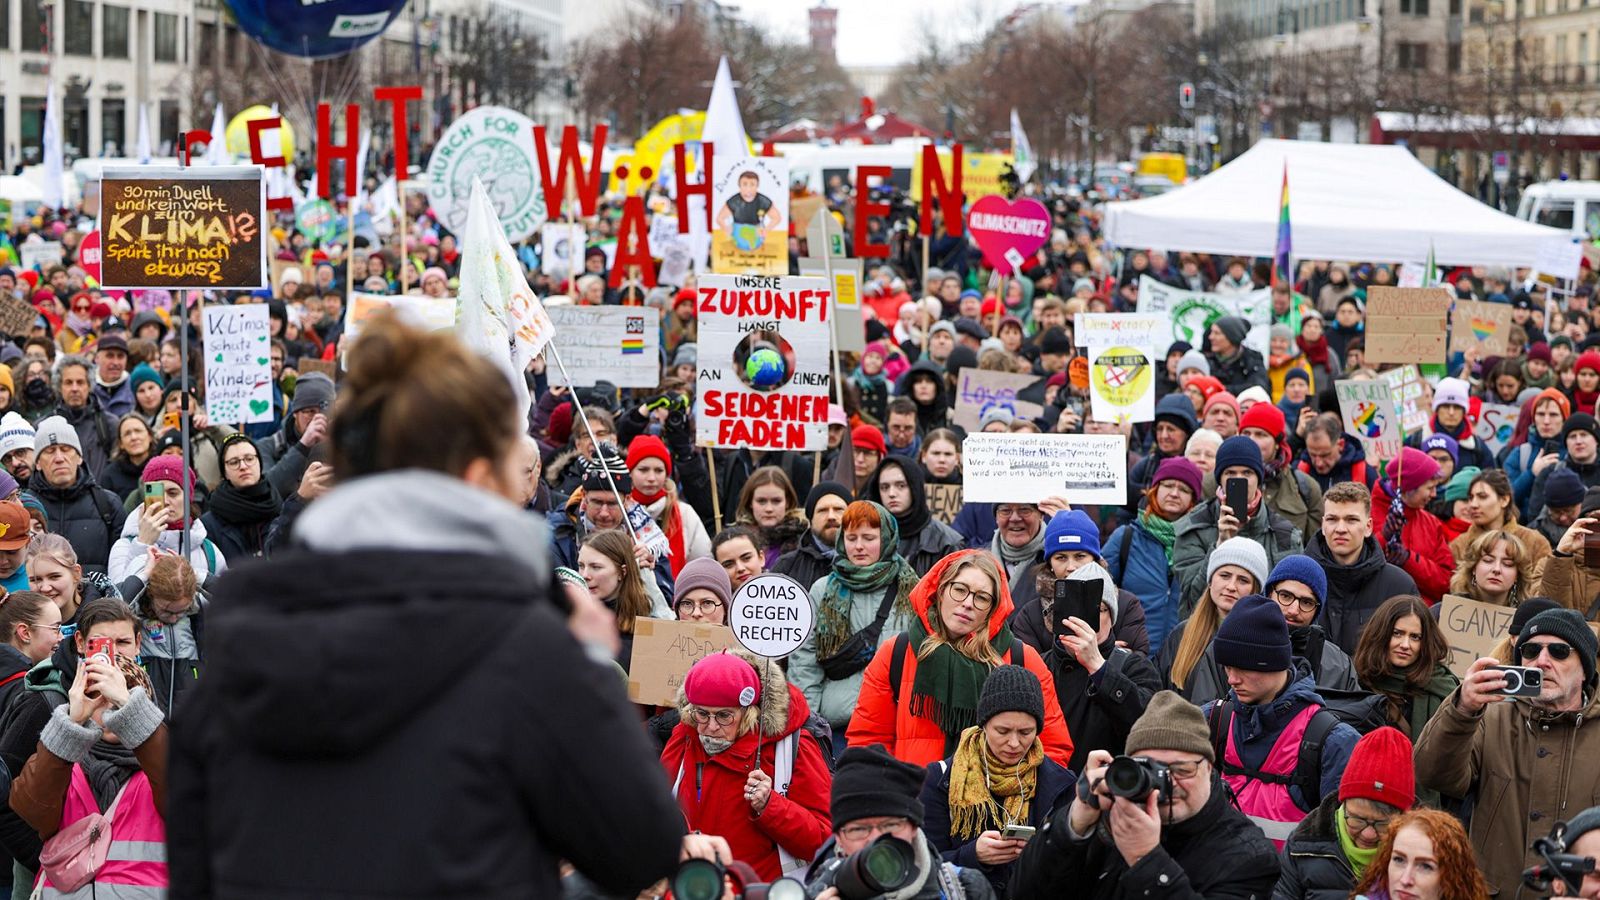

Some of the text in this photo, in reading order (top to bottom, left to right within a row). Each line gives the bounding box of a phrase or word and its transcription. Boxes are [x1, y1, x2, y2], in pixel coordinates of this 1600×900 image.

[432, 124, 473, 199] CHURCH
[483, 116, 519, 137] FOR
[173, 184, 213, 200] Duell
[115, 198, 229, 213] und kein Wort
[154, 210, 195, 221] zum
[970, 211, 1047, 238] KLIMASCHUTZ
[107, 241, 230, 263] Spürt ihr noch
[144, 258, 224, 284] etwas?
[734, 276, 782, 290] UNSERE
[699, 287, 831, 322] ZUKUNFT
[698, 369, 830, 386] AN EINEM
[703, 389, 829, 423] SEIDENEN
[718, 419, 806, 450] FADEN
[1040, 439, 1051, 447] die
[1019, 447, 1036, 457] Herr
[969, 458, 985, 466] Wer
[989, 458, 1005, 466] das
[971, 469, 990, 477] wird
[1009, 469, 1025, 477] uns
[746, 584, 797, 601] OMAS
[742, 604, 799, 621] GEGEN
[740, 625, 803, 642] RECHTS
